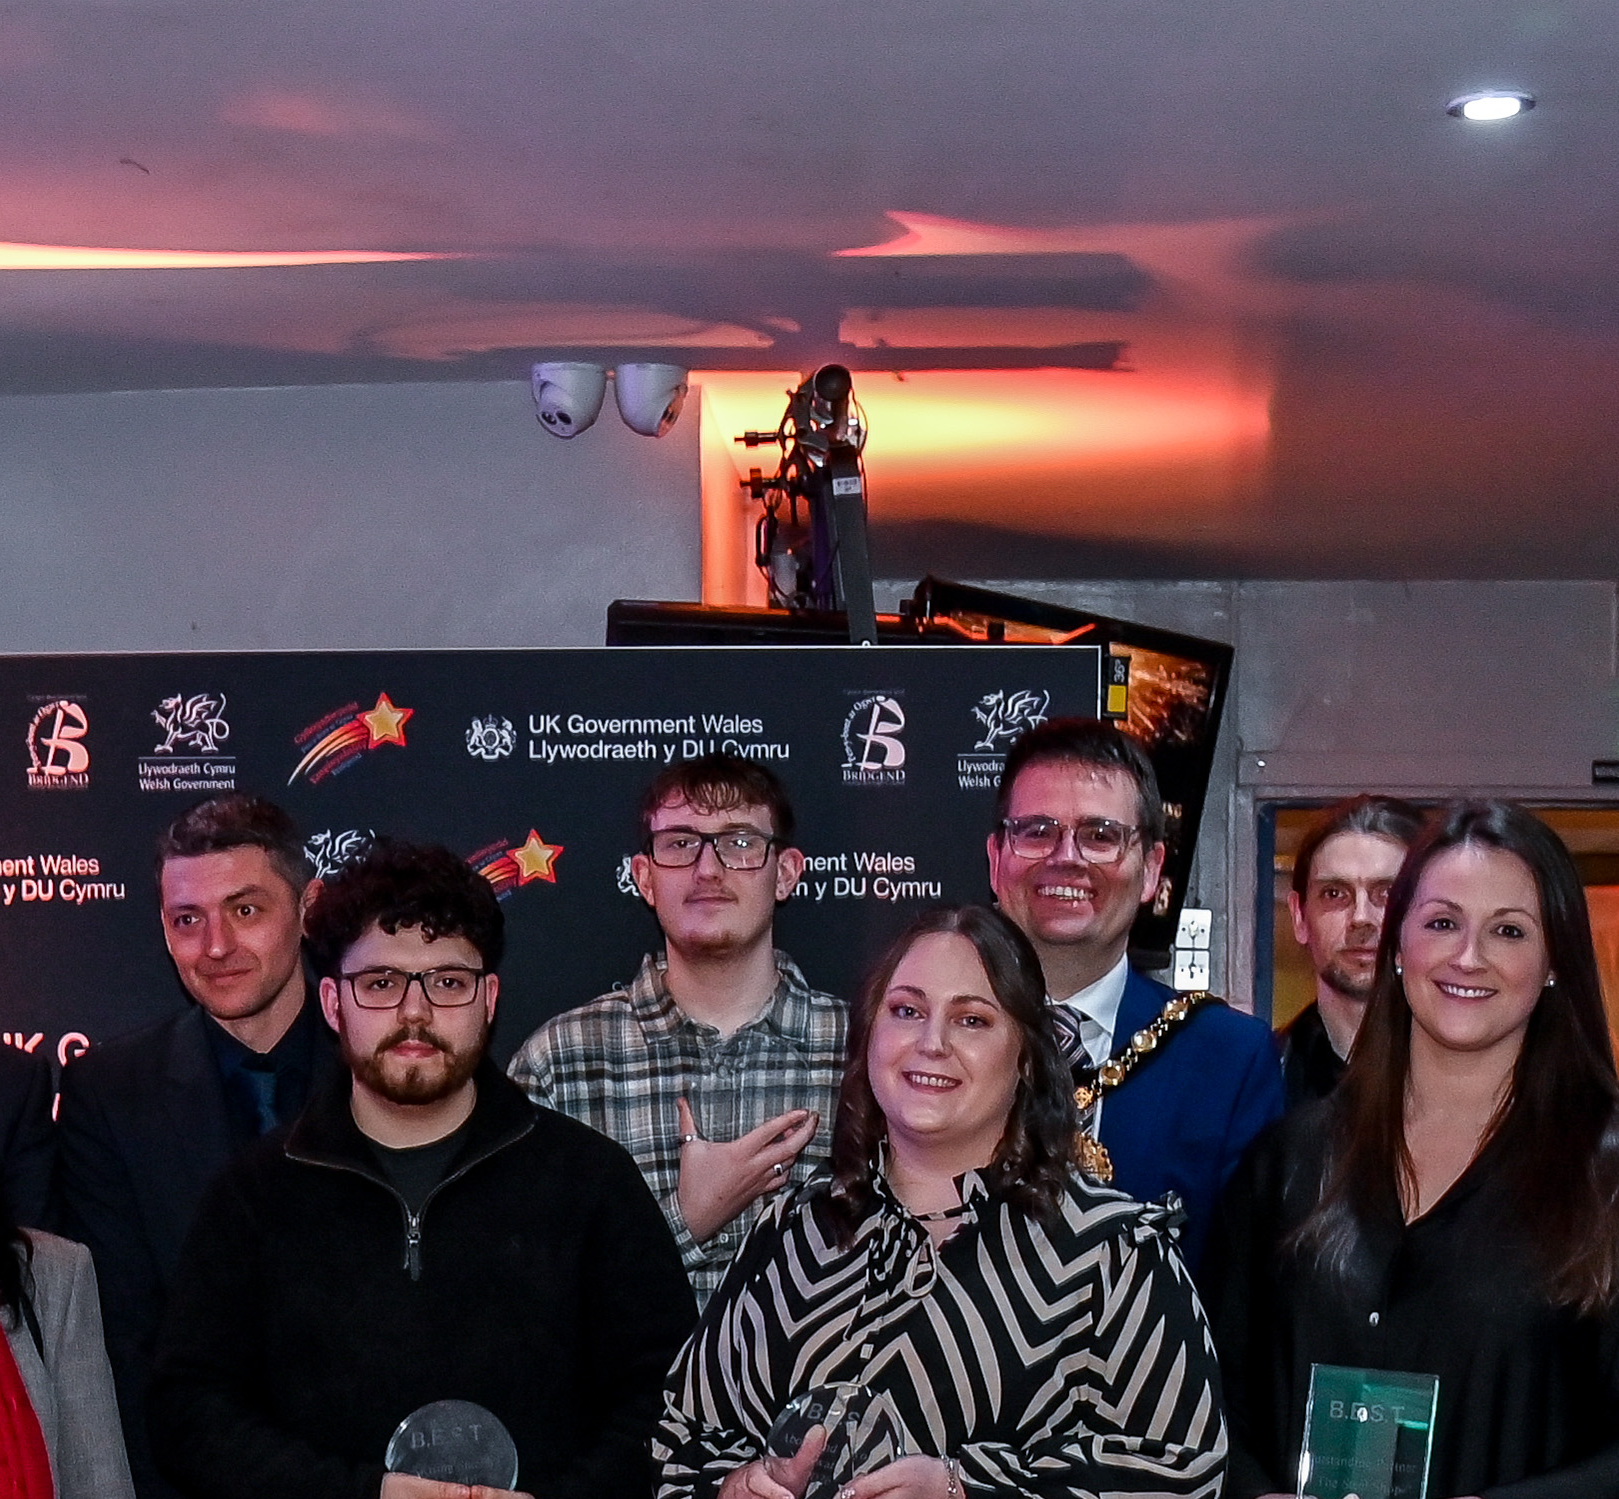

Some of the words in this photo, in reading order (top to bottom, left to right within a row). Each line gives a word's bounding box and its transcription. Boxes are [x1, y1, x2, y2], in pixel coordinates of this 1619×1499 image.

[528, 714, 561, 735] UK
[567, 714, 696, 736] Government
[701, 714, 763, 735] Wales
[528, 740, 657, 763] Llywodraeth
[663, 745, 676, 763] y
[138, 763, 200, 777] Llywodraeth
[204, 763, 236, 776] Cymru
[139, 778, 171, 791] Welsh
[173, 779, 235, 791] Government
[957, 777, 990, 789] Welsh
[40, 854, 100, 876] Wales
[854, 852, 916, 872] Wales
[3, 883, 16, 905] y
[22, 879, 53, 900] DU
[59, 879, 126, 905] Cymru
[834, 877, 867, 897] DU
[873, 877, 941, 901] Cymru
